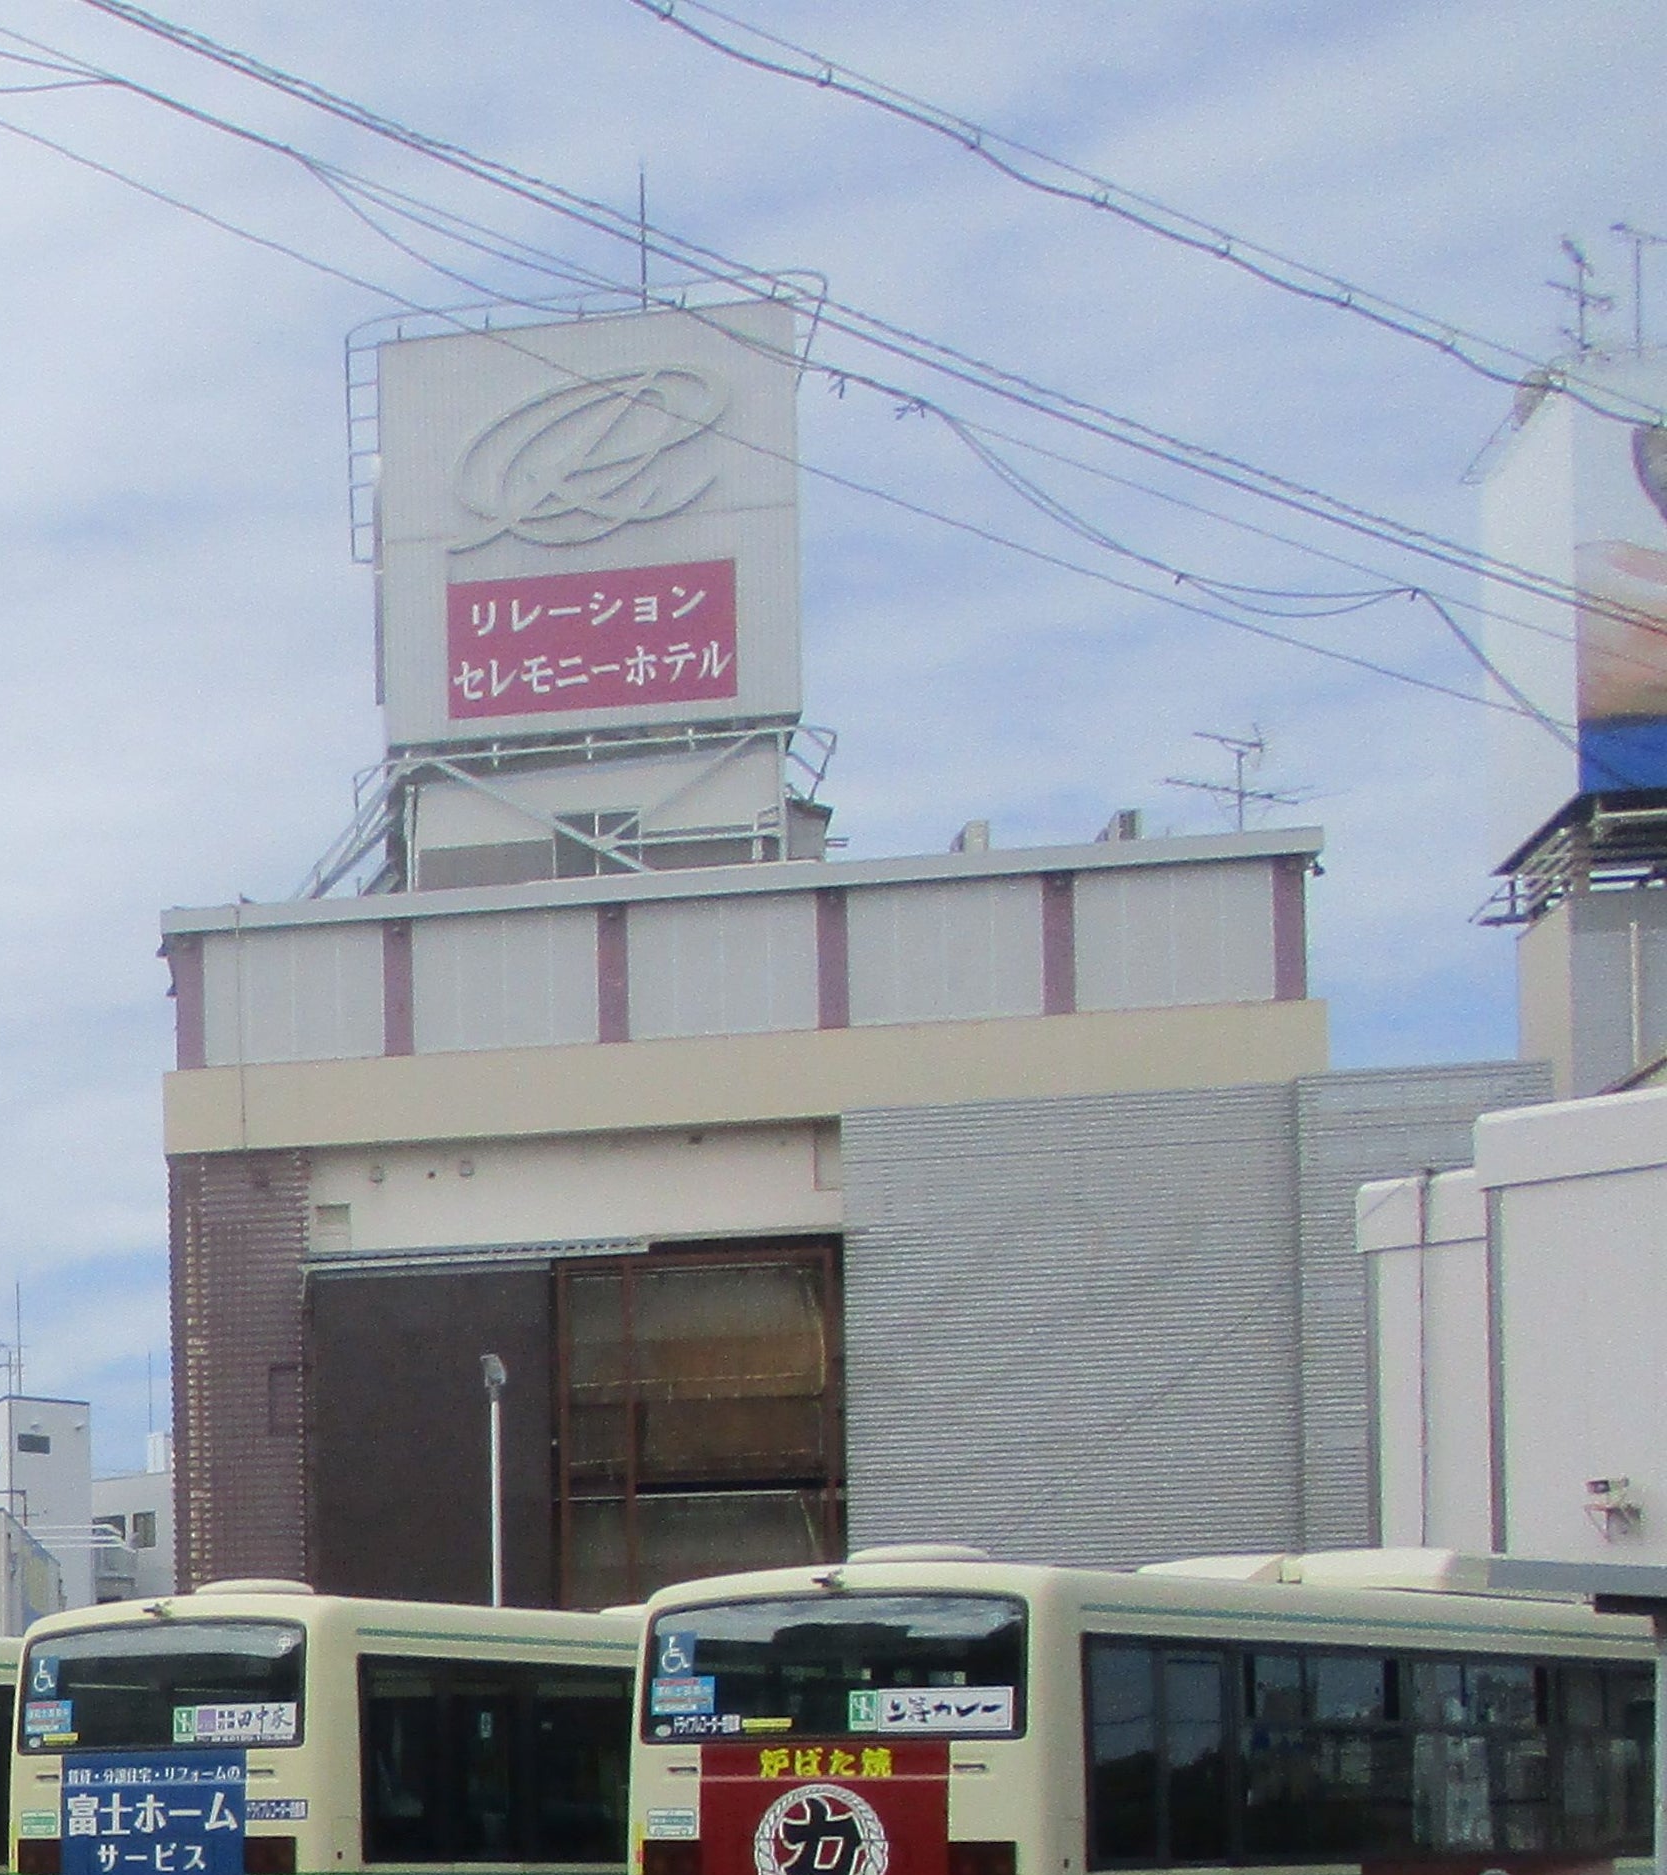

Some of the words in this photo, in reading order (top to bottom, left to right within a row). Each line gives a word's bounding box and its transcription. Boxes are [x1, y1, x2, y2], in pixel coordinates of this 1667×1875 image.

[471, 584, 707, 638] リレーション
[452, 640, 734, 702] セレモニーホテル
[238, 1705, 293, 1733] 田中家
[759, 1747, 893, 1778] 炉ばた焼
[67, 1791, 238, 1837] 富士ホーム
[97, 1843, 207, 1872] サービス
